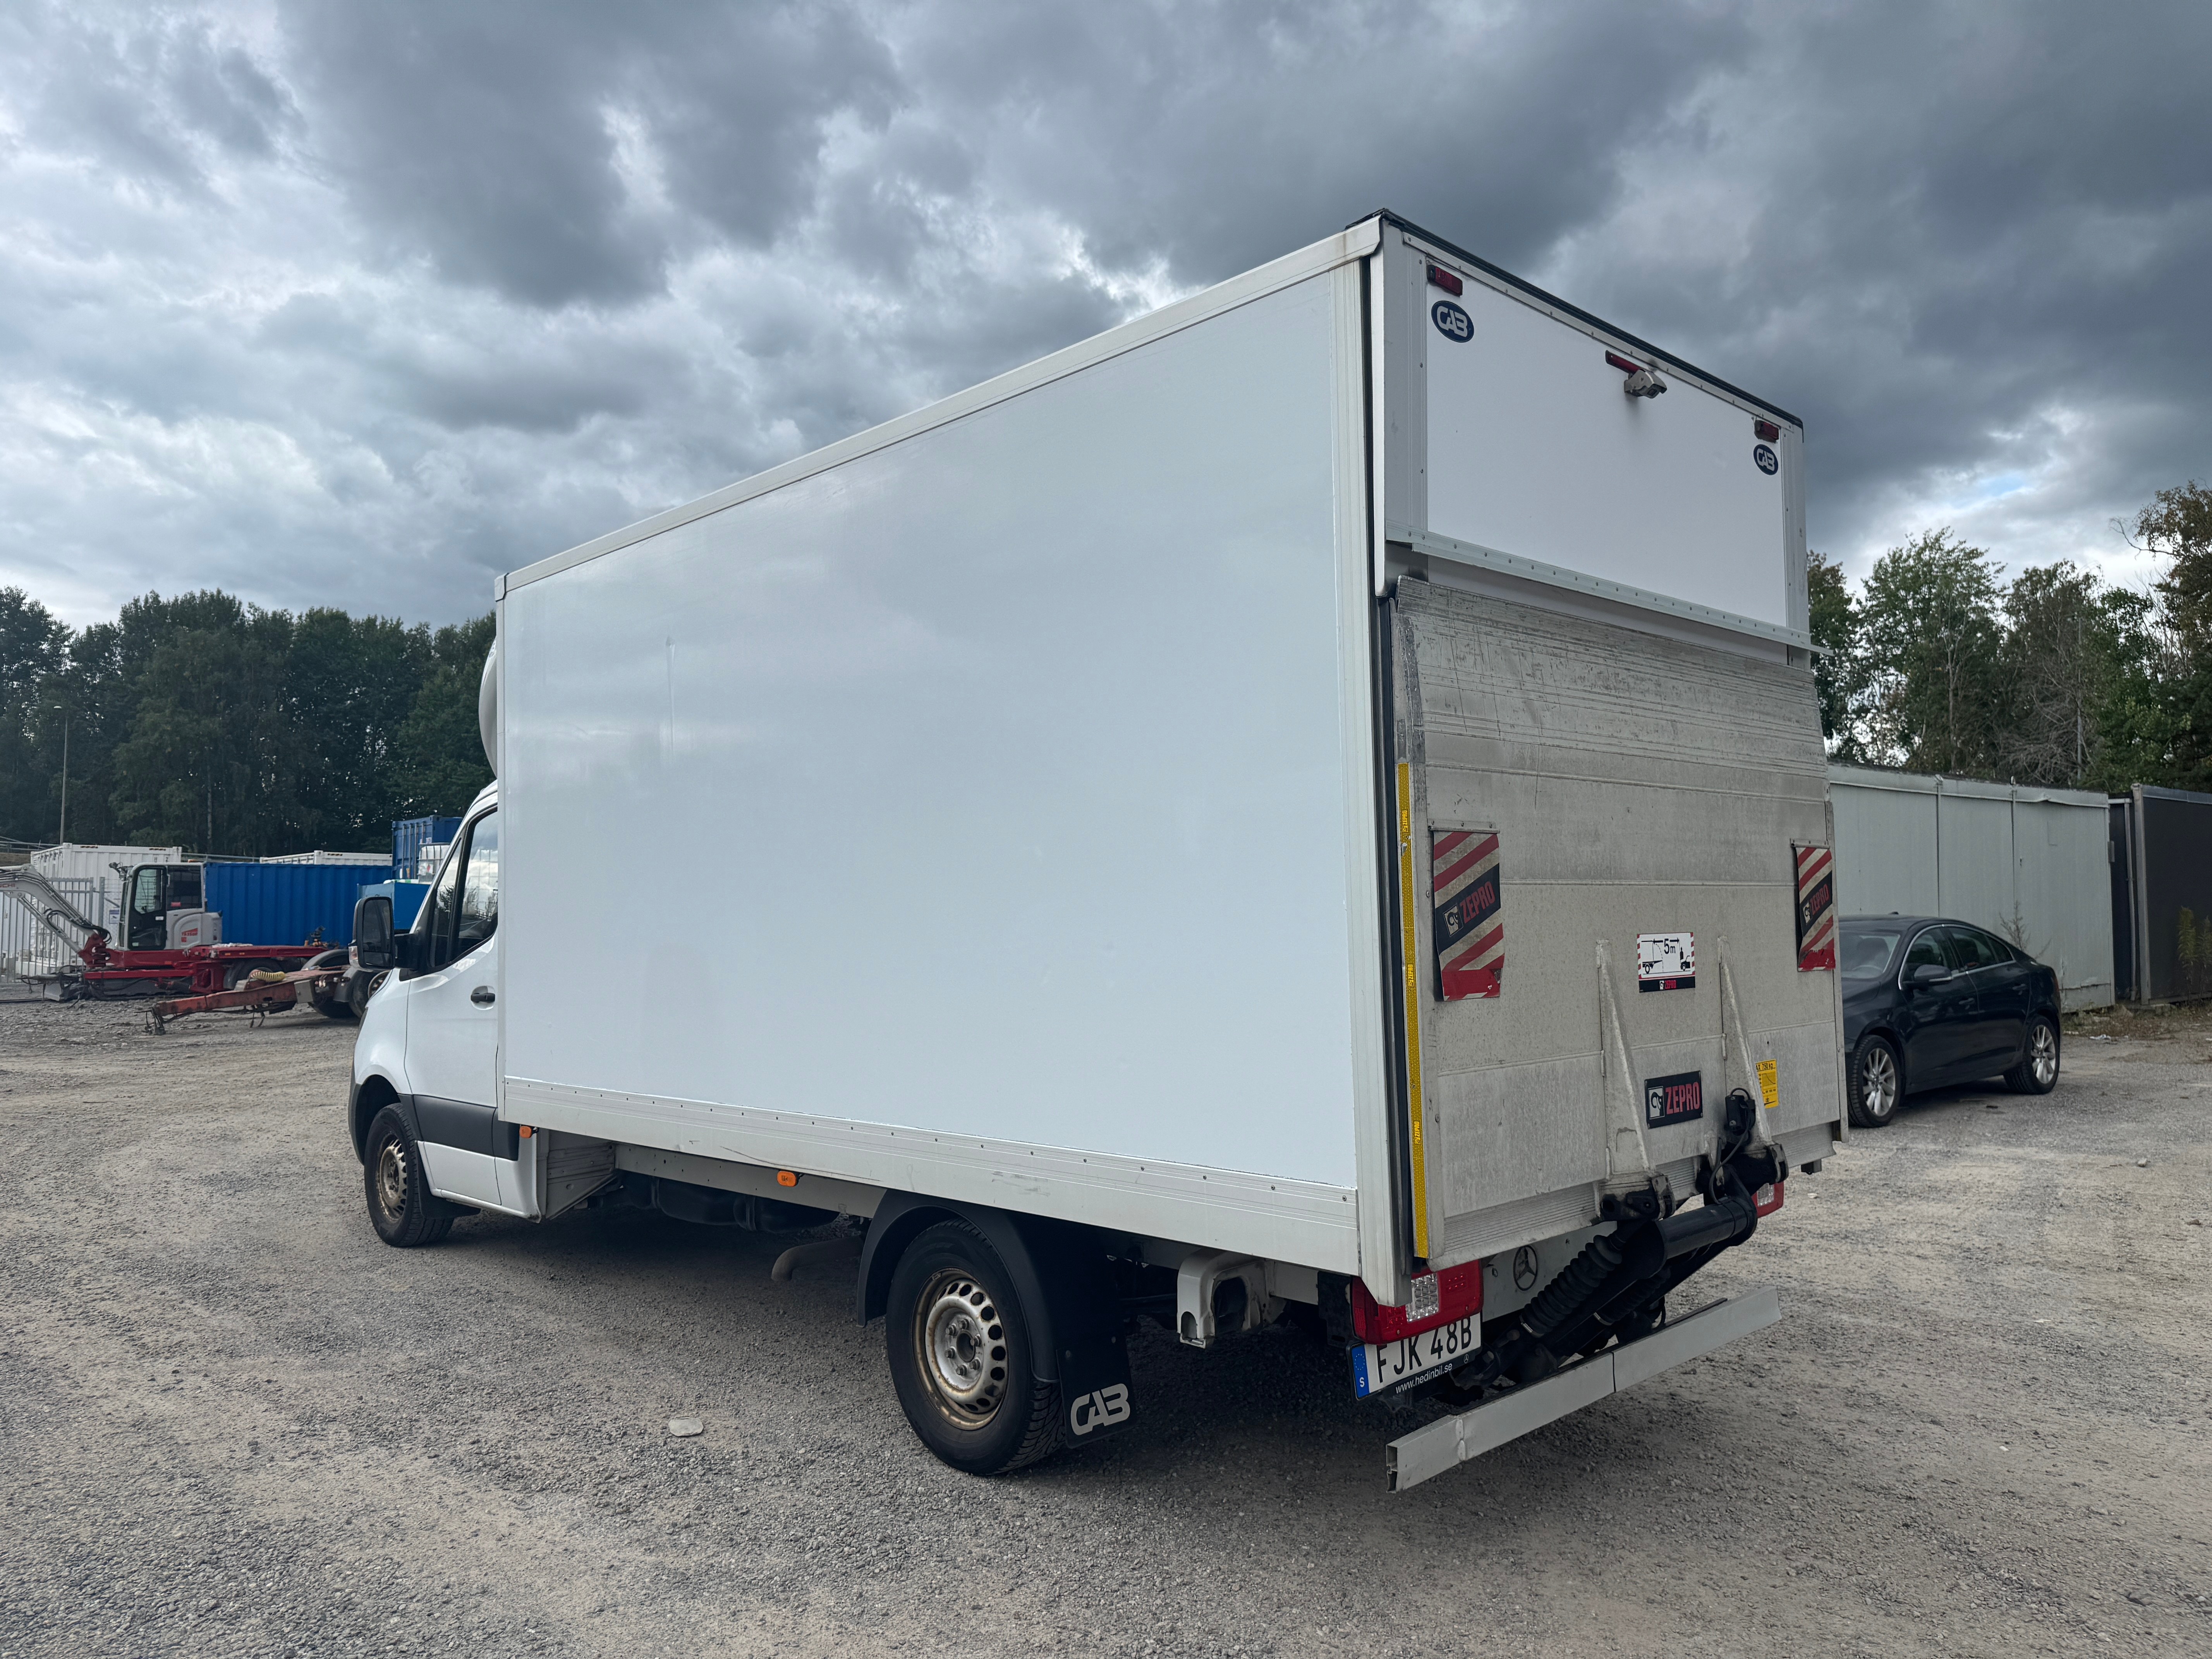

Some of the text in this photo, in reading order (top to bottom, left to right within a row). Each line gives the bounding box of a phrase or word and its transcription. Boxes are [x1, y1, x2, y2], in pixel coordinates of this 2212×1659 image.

[1437, 306, 1468, 337] CAB
[1757, 448, 1775, 471] CAB
[1460, 881, 1495, 924] ZEPRO
[1810, 884, 1829, 915] ZEPRO
[1666, 1082, 1700, 1115] ZEPRO
[1376, 1317, 1472, 1383] FJK 48B
[1359, 1377, 1365, 1388] S
[1395, 1363, 1453, 1394] www.hedinbil.se
[1070, 1383, 1130, 1436] CAB
